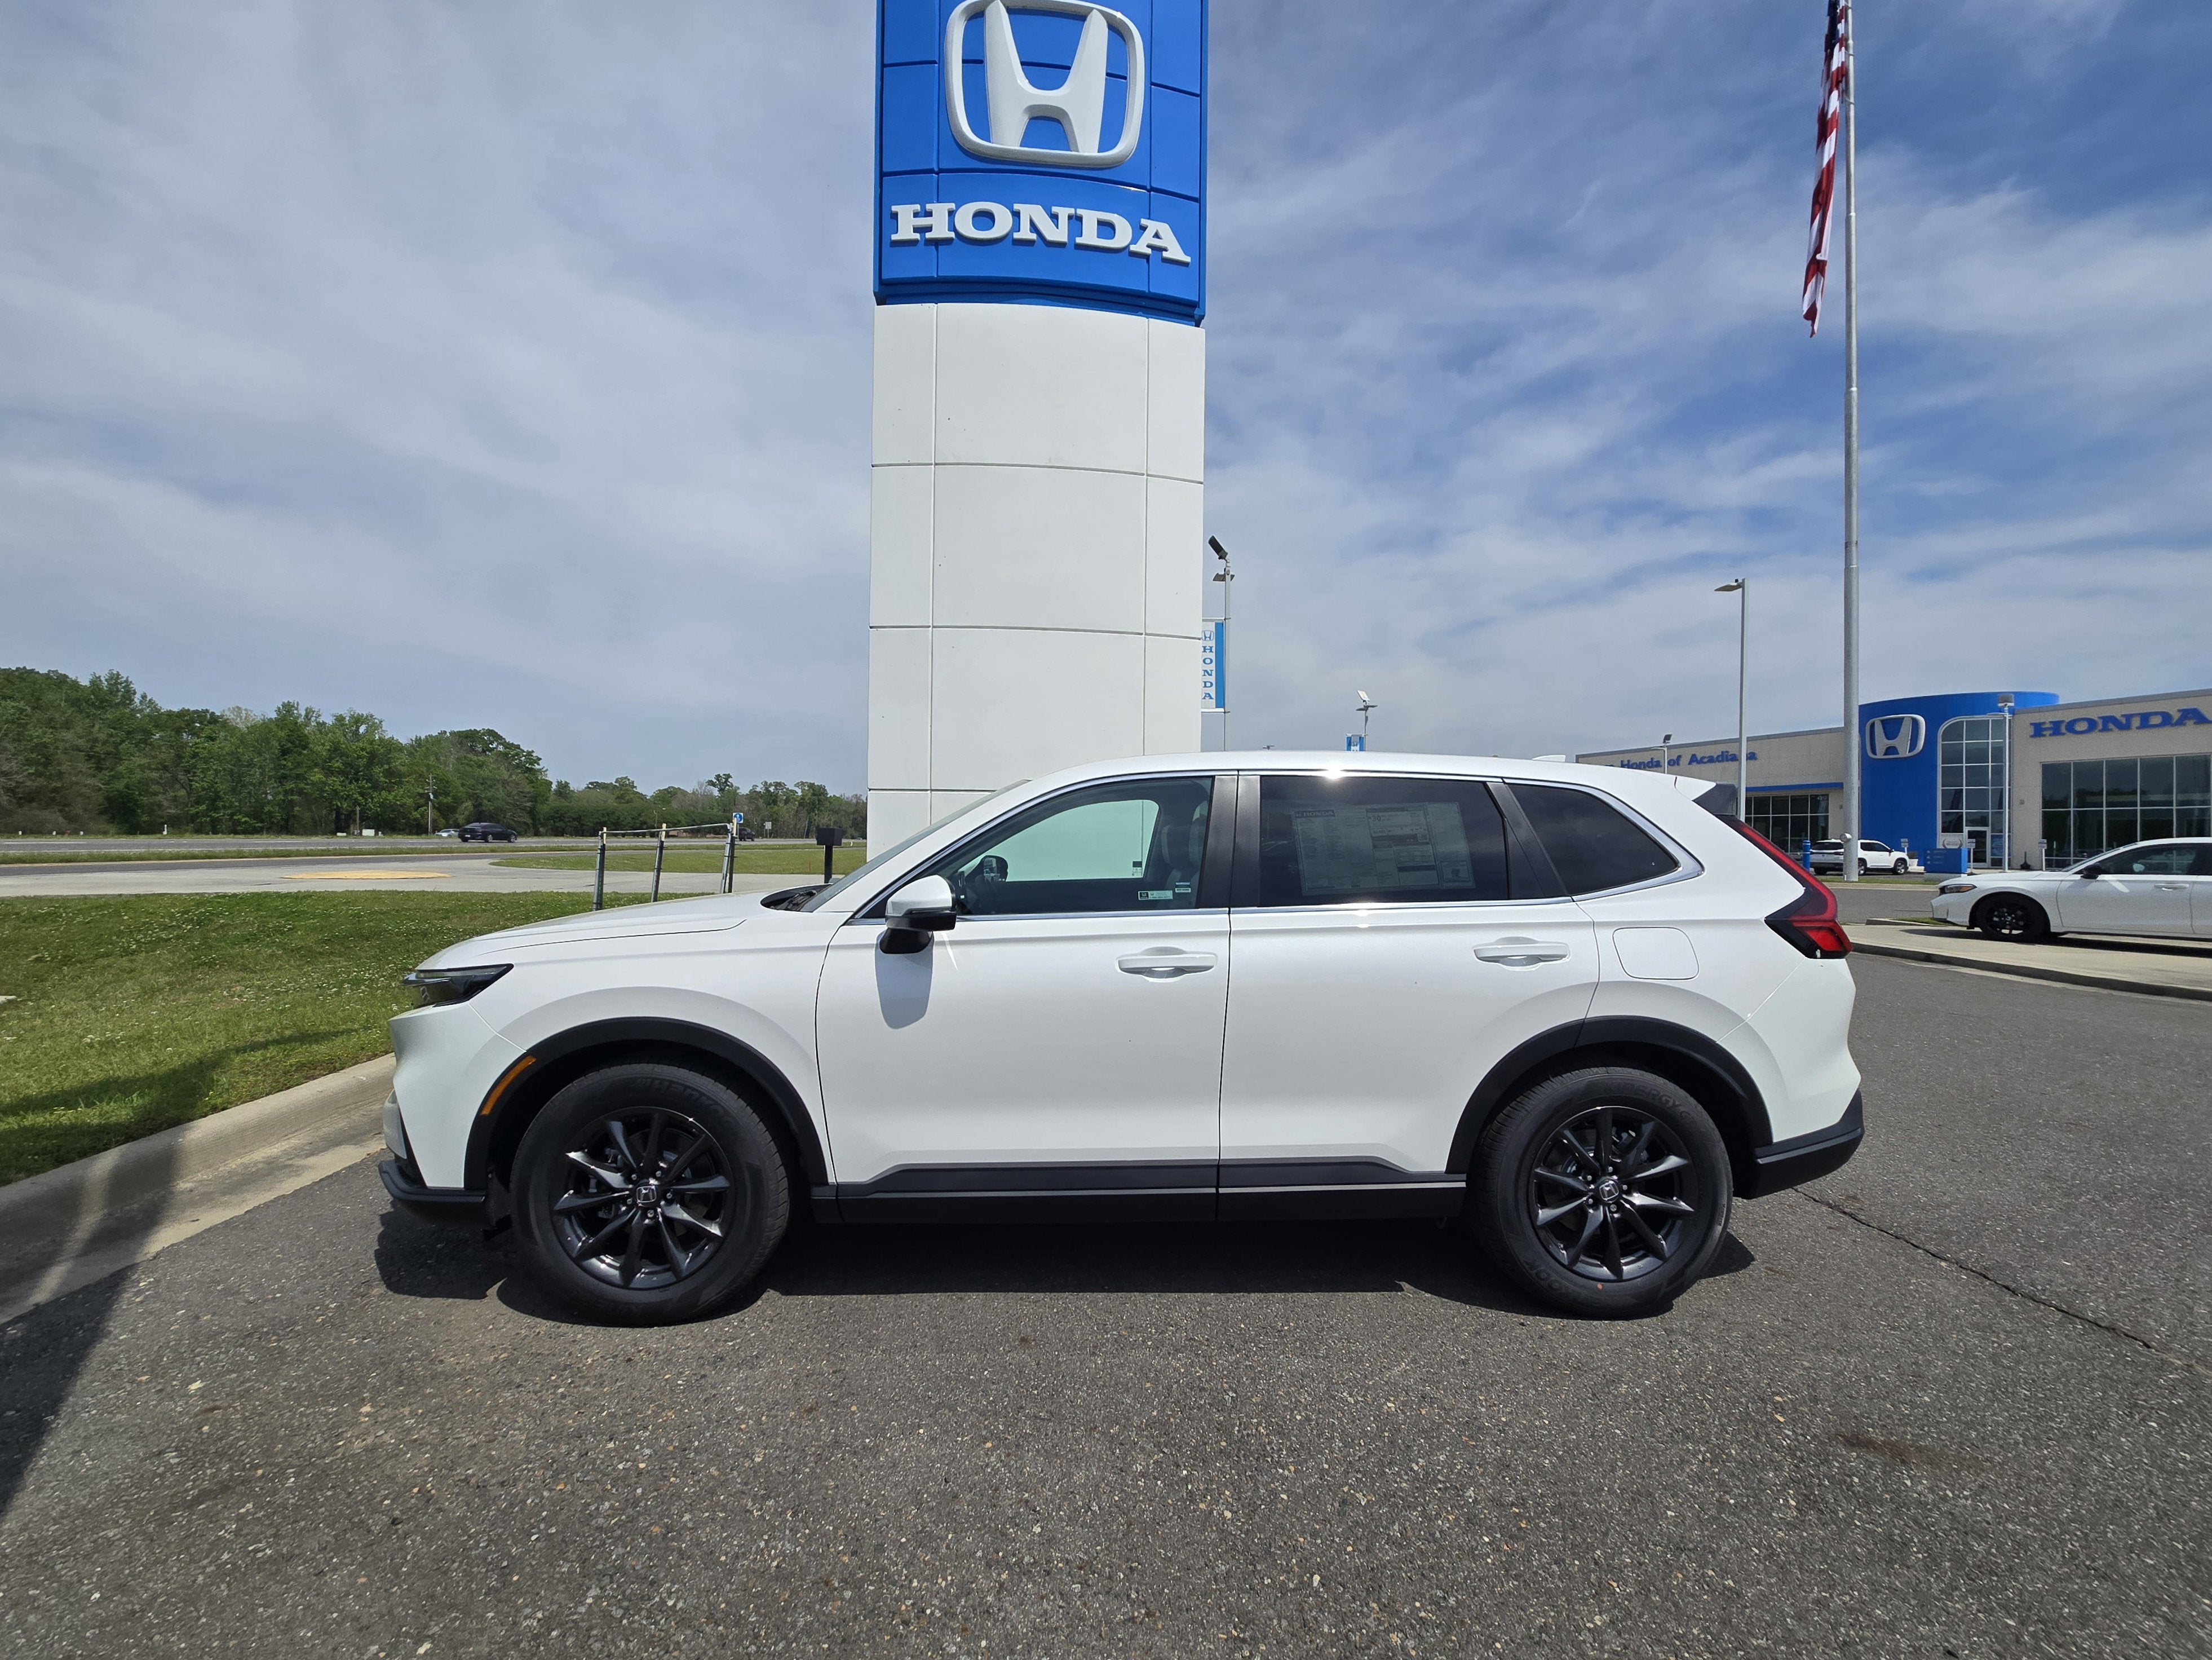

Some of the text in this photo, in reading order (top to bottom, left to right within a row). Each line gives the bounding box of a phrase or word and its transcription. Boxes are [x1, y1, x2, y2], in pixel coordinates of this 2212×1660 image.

[891, 201, 1191, 266] HONDA
[1201, 646, 1214, 700] HONDA
[2029, 707, 2212, 738] HONDA
[1620, 750, 1758, 770] Honda of Acadiaa
